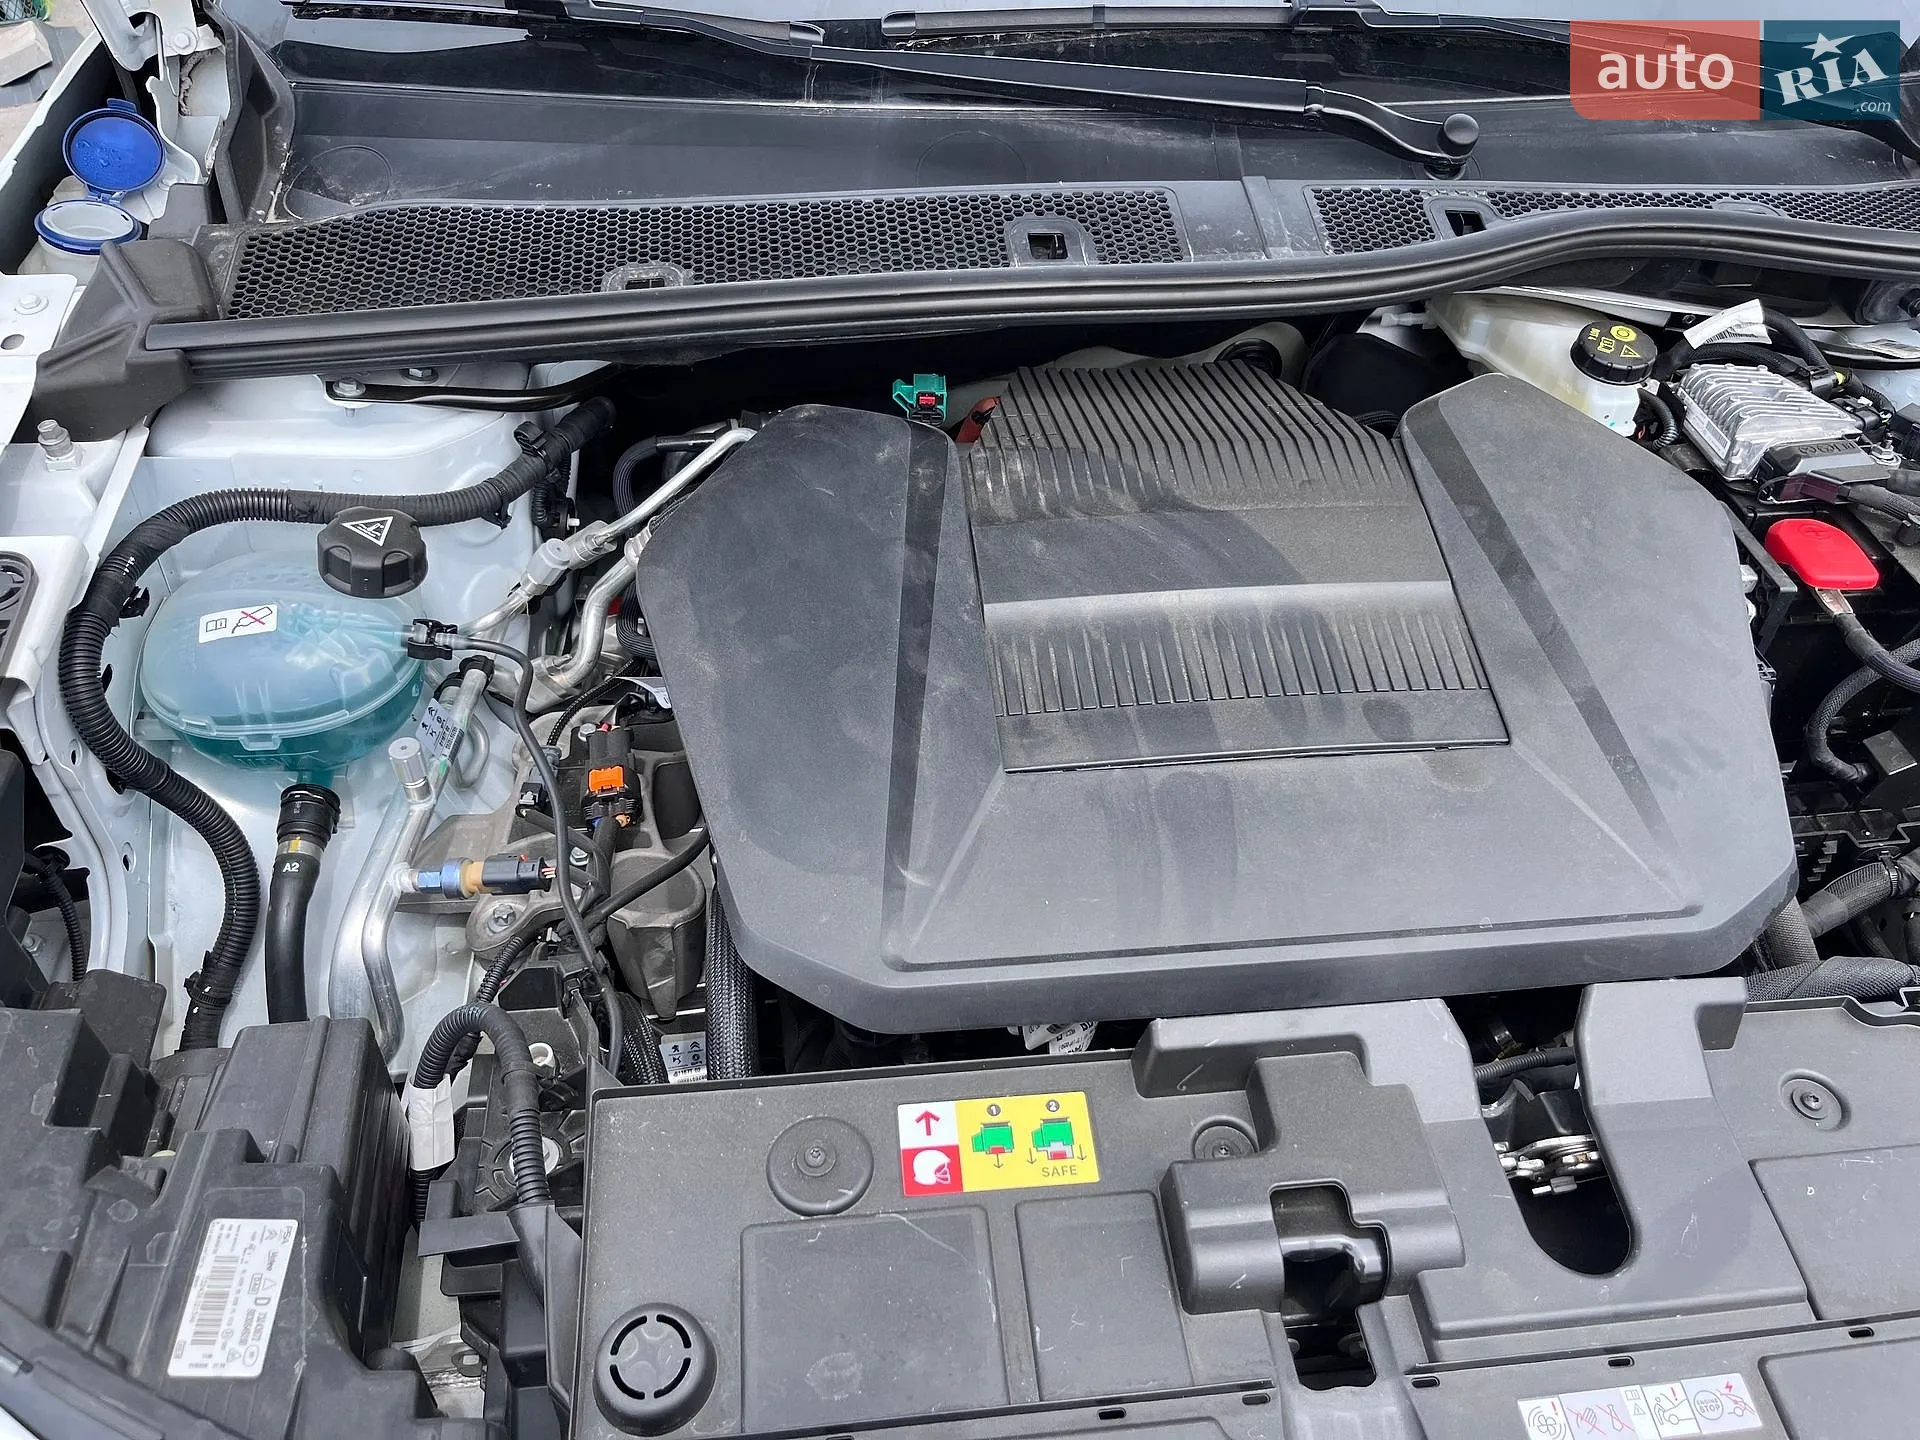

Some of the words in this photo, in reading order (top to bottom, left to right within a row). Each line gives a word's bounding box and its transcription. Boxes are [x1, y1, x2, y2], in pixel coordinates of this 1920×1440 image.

[283, 863, 300, 872] A2
[1042, 1165, 1077, 1177] SAFE
[1700, 1404, 1720, 1413] STOP
